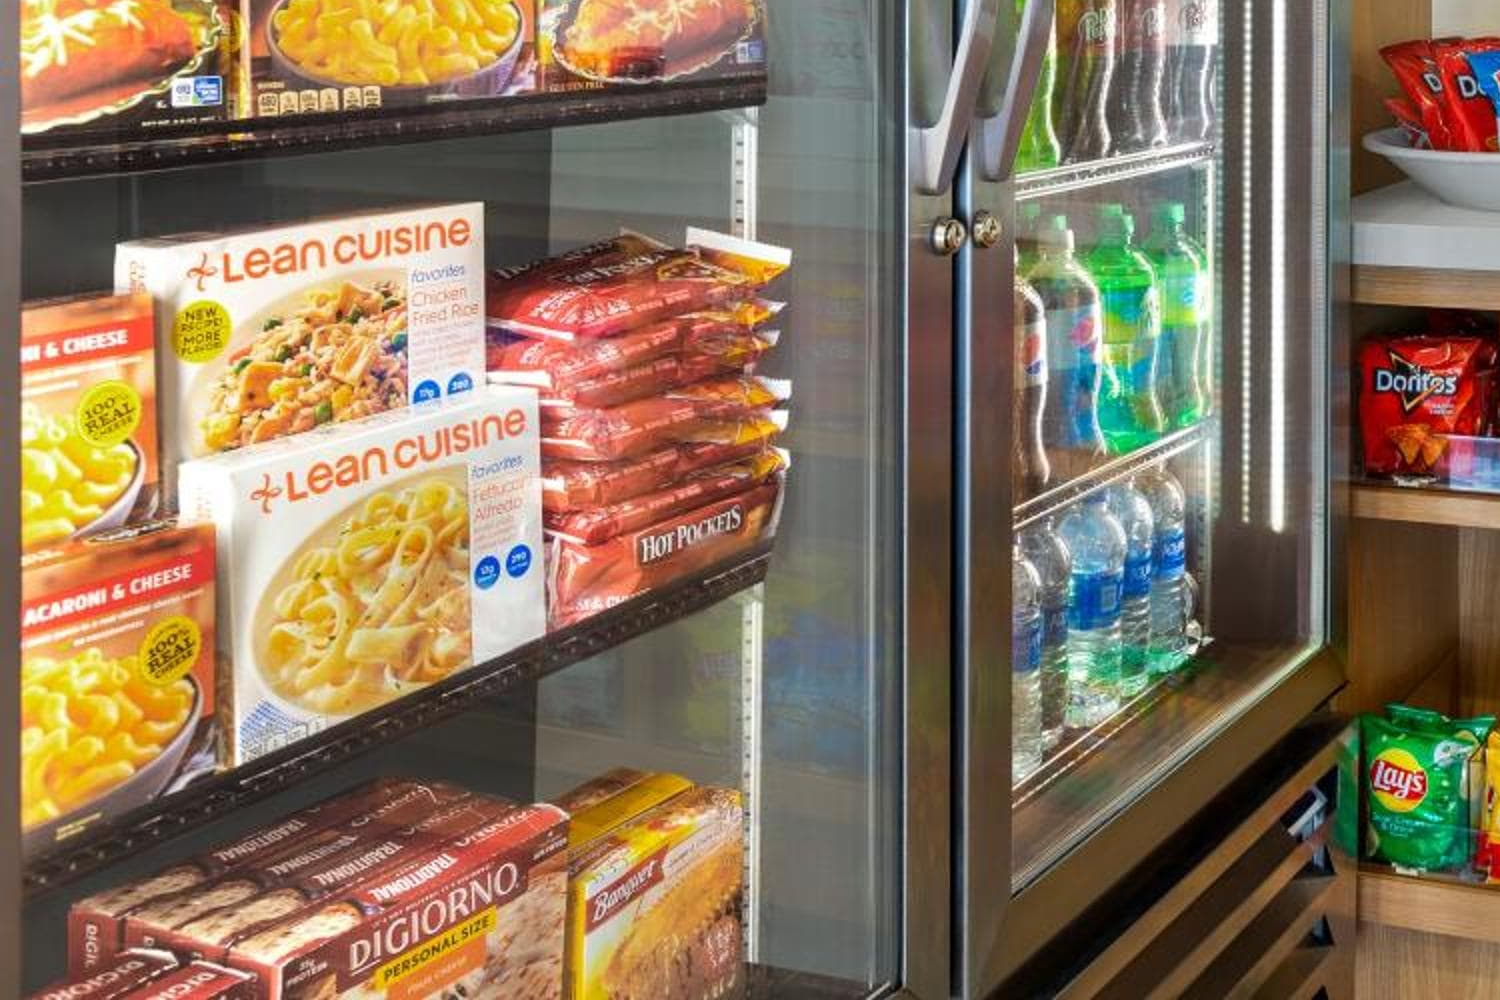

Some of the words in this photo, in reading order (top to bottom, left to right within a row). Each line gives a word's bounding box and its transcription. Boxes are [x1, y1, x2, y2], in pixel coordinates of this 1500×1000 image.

[222, 238, 326, 284] Lean
[185, 307, 218, 322] NEW
[411, 286, 467, 309] Chicken
[63, 328, 129, 356] CHEESE
[182, 330, 221, 347] MORE
[1376, 368, 1458, 395] Doritos
[85, 402, 136, 435] REAL
[285, 446, 389, 502] Lean
[640, 529, 678, 564] HOT
[677, 503, 743, 551] POCKETS
[22, 587, 108, 628] ACARONI
[112, 584, 125, 601] &
[129, 563, 194, 595] CHEESE
[146, 635, 196, 674] REAL
[1374, 761, 1425, 799] Lay's
[367, 853, 459, 902] TRADITIONAL
[381, 934, 460, 983] PERSONAL
[460, 913, 490, 941] SIZE
